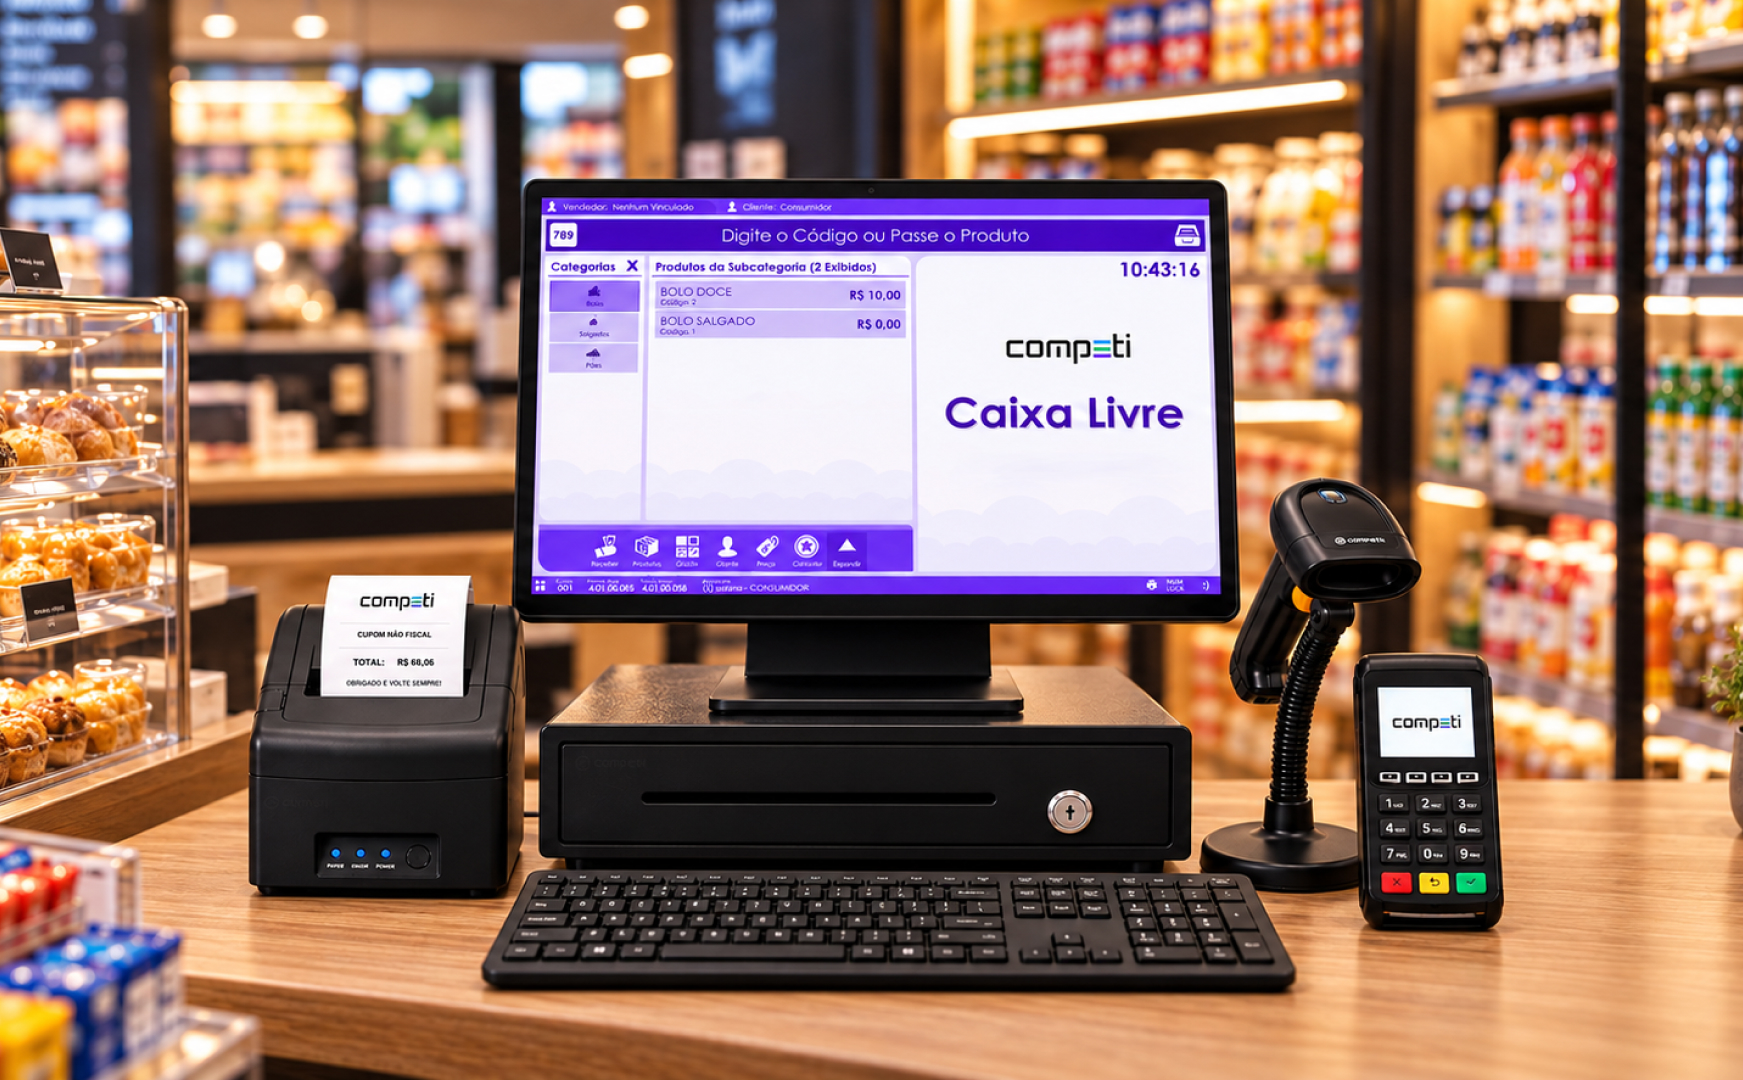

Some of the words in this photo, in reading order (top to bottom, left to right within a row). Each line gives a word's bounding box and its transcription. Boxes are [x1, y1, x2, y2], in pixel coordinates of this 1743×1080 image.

[612, 202, 649, 211] Nenhum
[650, 202, 694, 212] Vinculado
[779, 202, 833, 212] Consumidor
[553, 229, 577, 241] 789
[721, 228, 772, 246] Digite
[776, 231, 789, 243] o
[792, 227, 859, 247] Código
[863, 231, 886, 243] ou
[890, 228, 940, 243] Passe
[943, 231, 956, 243] o
[960, 228, 1030, 243] Produto
[550, 261, 616, 274] Categorias
[655, 261, 706, 272] Produtos
[708, 261, 725, 272] da
[727, 261, 807, 275] Subcategoria
[809, 261, 822, 274] (2
[824, 261, 877, 274] Exibidos)
[1119, 261, 1201, 278] 10:43:16
[660, 286, 694, 297] BOLO
[696, 286, 733, 297] DOCE
[849, 289, 865, 302] R$
[867, 289, 901, 302] 10,00
[660, 316, 694, 327] BOLO
[696, 316, 756, 327] SALGADO
[857, 318, 873, 331] R$
[874, 318, 901, 331] 0,00
[1005, 333, 1132, 365] competi
[944, 395, 1073, 430] Caixa
[1088, 395, 1184, 430] Livre
[359, 592, 435, 611] competi
[356, 631, 386, 639] CUPOM
[387, 629, 404, 639] NÃO
[405, 631, 433, 639] FISCAL
[352, 658, 386, 667] TOTAL:
[396, 658, 409, 668] R$
[345, 679, 382, 688] OBRIGADO
[382, 679, 388, 687] E
[389, 679, 411, 688] VOLTE
[412, 679, 443, 688] SEMPRE!
[1391, 714, 1463, 732] competi
[1385, 798, 1392, 809] 1
[1421, 797, 1430, 809] 2
[1458, 798, 1466, 809] 3
[1385, 822, 1394, 834] 4
[1422, 822, 1431, 834] 5
[1458, 822, 1467, 834] 6
[1386, 848, 1395, 860] 7
[1423, 848, 1432, 860] 0
[1459, 848, 1469, 860] 9
